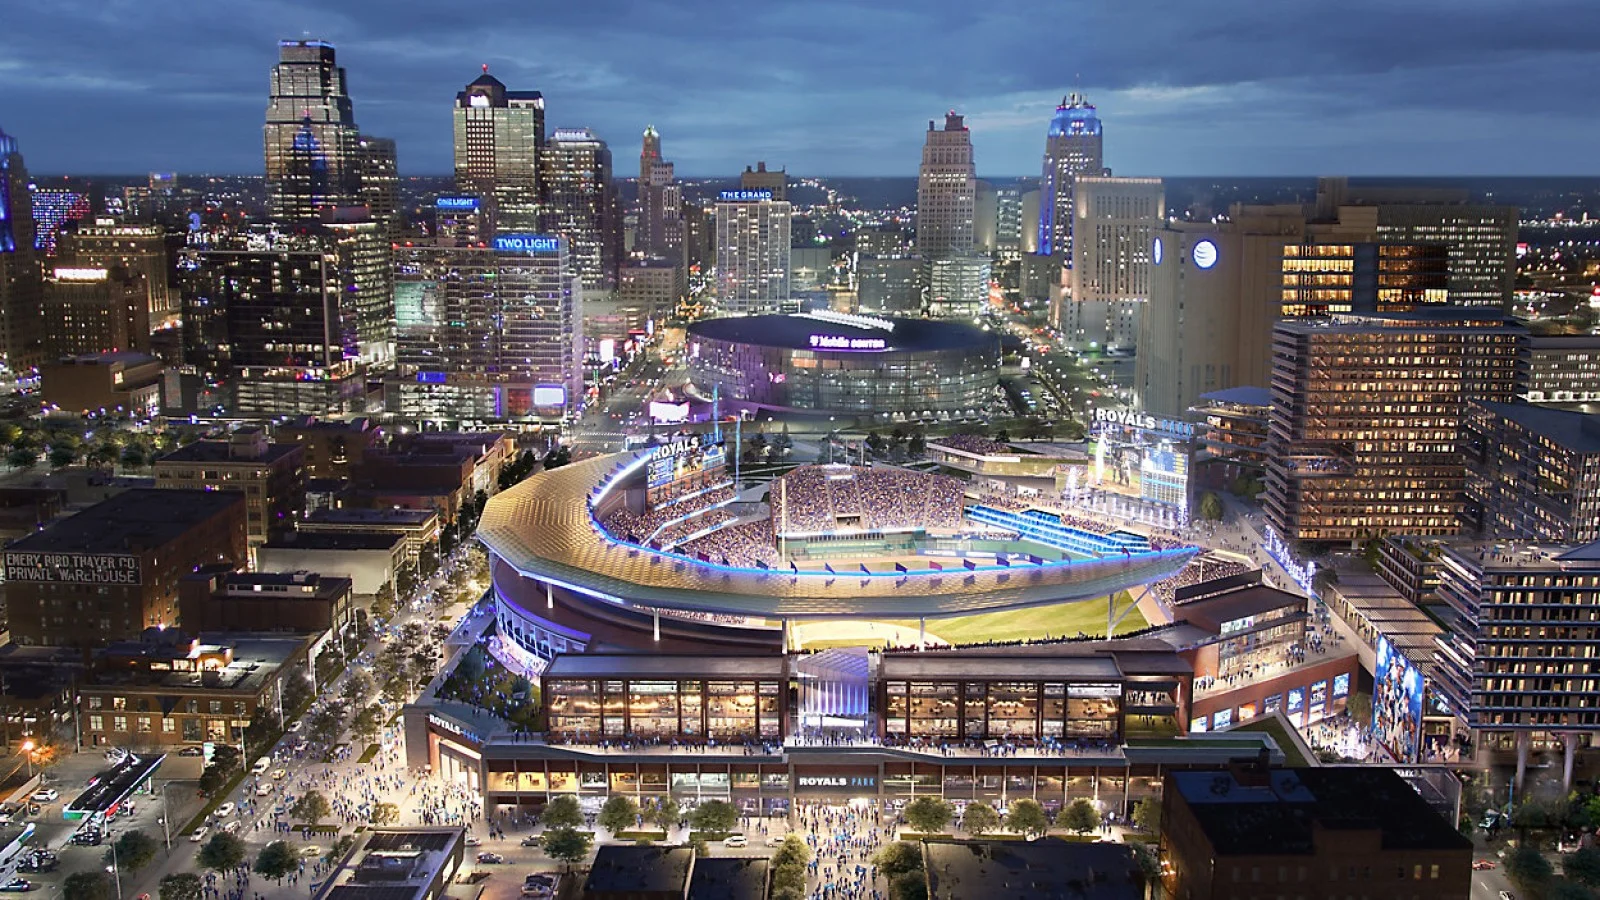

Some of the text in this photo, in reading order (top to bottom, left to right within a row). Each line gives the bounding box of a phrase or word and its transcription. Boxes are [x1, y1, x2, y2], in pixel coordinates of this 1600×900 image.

[497, 238, 557, 249] TWO LIGHT
[1096, 407, 1156, 430] ROYALS
[1161, 418, 1193, 437] PARK
[653, 435, 699, 461] ROYALS
[6, 553, 40, 567] EMERY
[72, 555, 115, 569] THAYER
[9, 566, 54, 581] PRIVATE
[429, 713, 460, 736] ROYALS
[799, 777, 874, 787] ROYALS PARK
